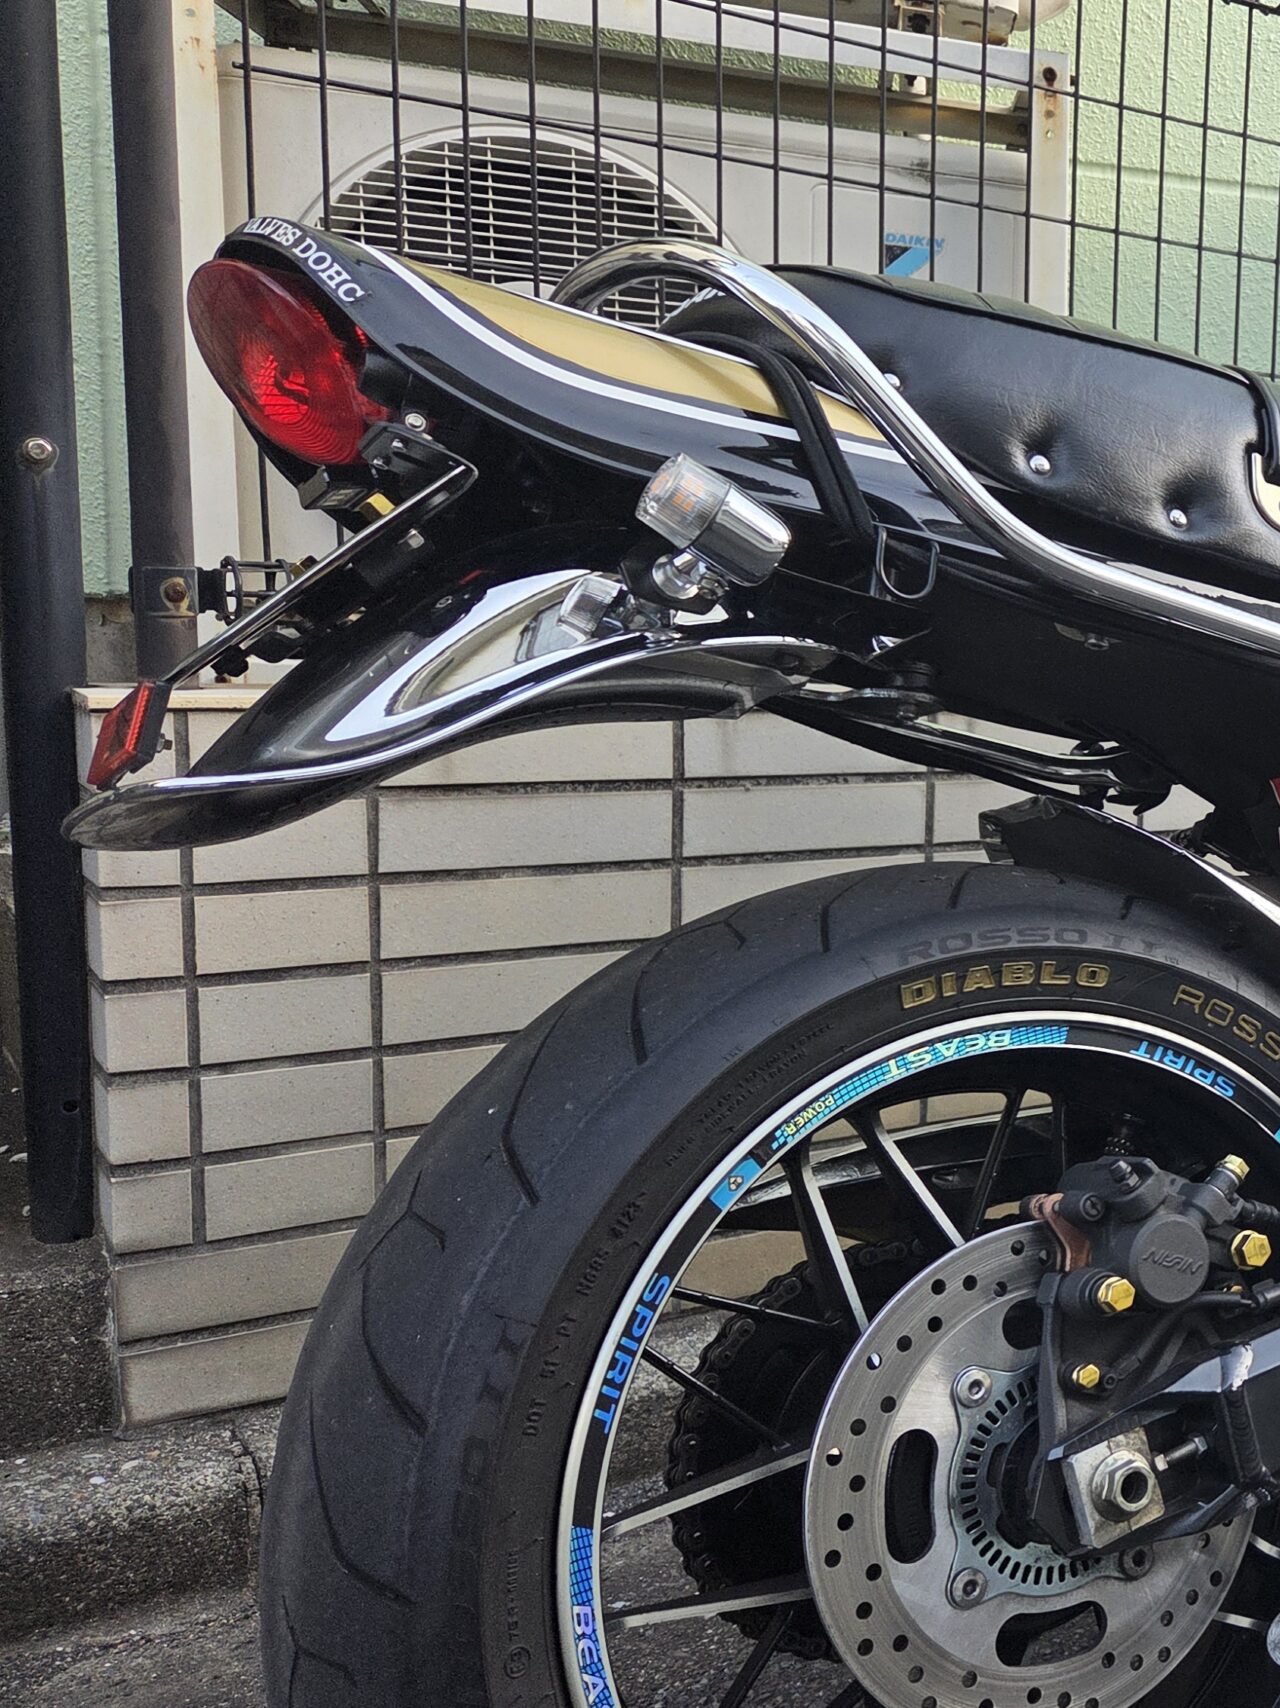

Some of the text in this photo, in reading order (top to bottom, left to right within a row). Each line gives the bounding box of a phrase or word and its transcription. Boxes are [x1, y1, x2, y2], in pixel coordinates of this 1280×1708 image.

[292, 237, 365, 302] DOHC
[903, 926, 1089, 966] ROSSO
[901, 960, 1111, 1009] DIABLO
[884, 1029, 1012, 1080] BEAST
[1130, 1040, 1237, 1098] SPIRIT
[784, 1093, 836, 1136] POWER
[593, 1272, 672, 1435] SPIRIT
[573, 1605, 615, 1708] BEA
